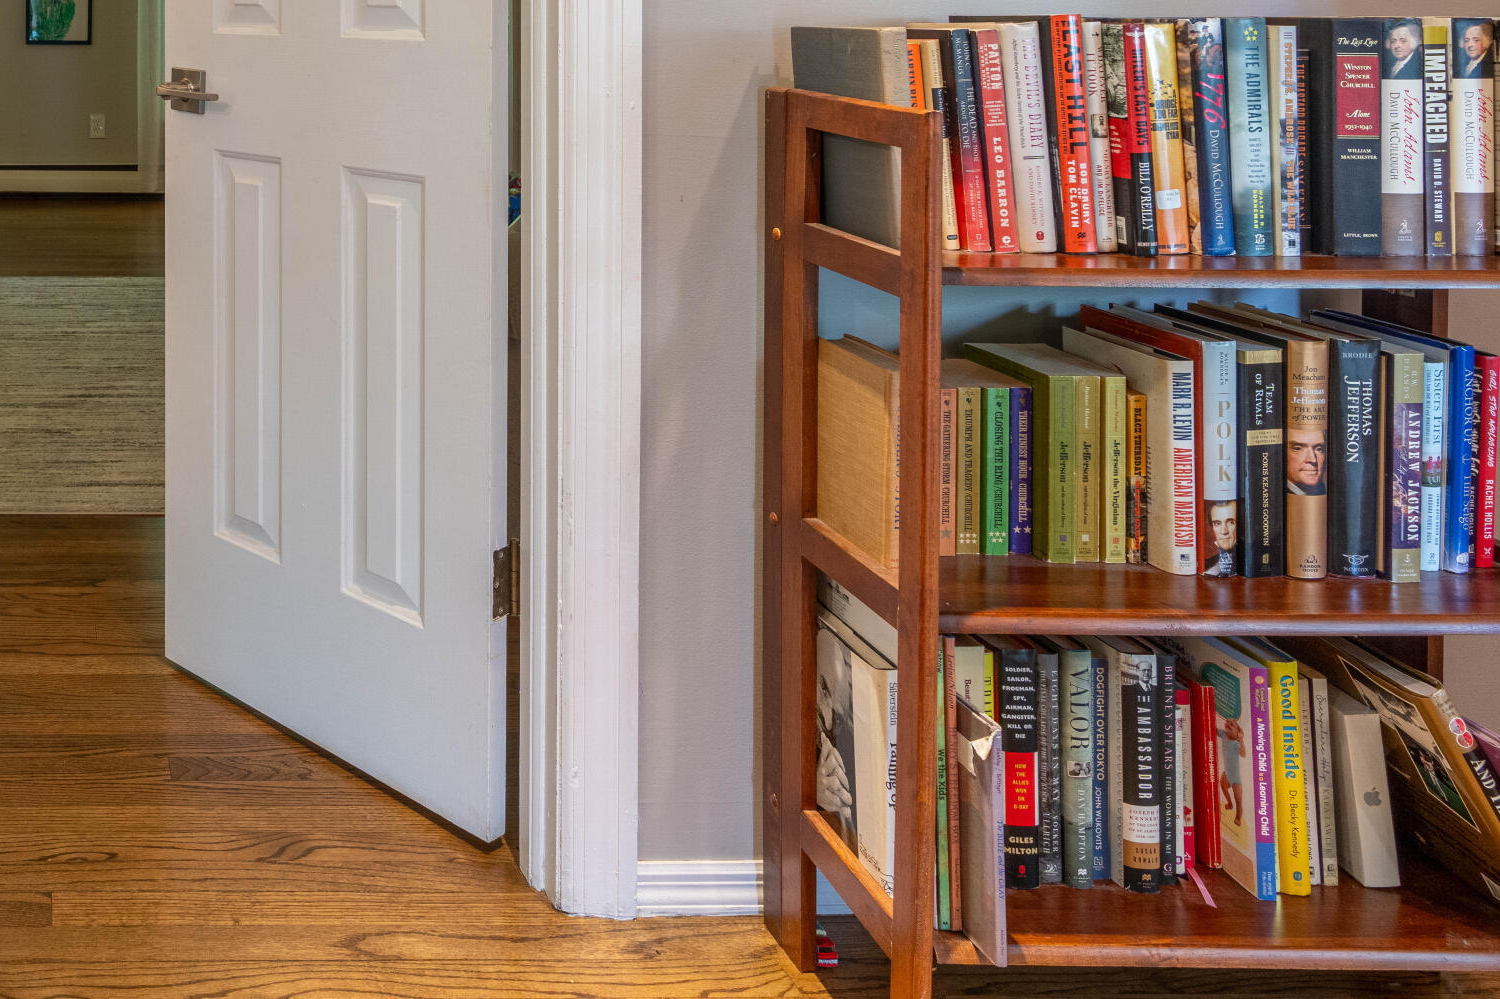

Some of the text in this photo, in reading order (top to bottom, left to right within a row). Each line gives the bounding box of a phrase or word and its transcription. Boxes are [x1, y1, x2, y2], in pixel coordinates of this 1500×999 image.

[988, 43, 1003, 90] PATTON
[1244, 45, 1260, 68] THE
[1337, 37, 1350, 46] The
[966, 86, 978, 128] THE DEAD
[1024, 65, 1045, 149] DEVIL'S DIARY
[1062, 29, 1087, 154] LAST HILL
[1087, 69, 1098, 97] TOOK
[1195, 72, 1226, 129] 1776
[1246, 72, 1263, 134] ADMIRALS
[1389, 92, 1401, 118] DAVID
[1424, 48, 1448, 145] IMPEACHED
[1464, 91, 1475, 118] DAVID
[961, 122, 971, 149] TO DIE
[1134, 94, 1149, 146] LAST DAYS
[1345, 109, 1371, 118] Alone
[992, 136, 1004, 163] LEO
[1209, 129, 1221, 160] DAVID
[1286, 159, 1295, 179] THE
[996, 169, 1010, 228] BARRON
[1067, 159, 1080, 228] TOM CLAVIN
[1079, 162, 1091, 225] BOB DRURY
[1138, 161, 1154, 232] BILL O'REILLY
[1433, 158, 1443, 223] DAVID STEWART
[1293, 386, 1325, 395] Thomas
[1304, 365, 1318, 373] Jon
[1433, 369, 1443, 412] Sisters
[1171, 372, 1193, 441] MARK LEVIN
[1255, 373, 1264, 426] OF RIVALS
[1265, 383, 1275, 414] TEAM
[1343, 375, 1361, 463] JEFFERSON
[1362, 378, 1373, 437] THOMAS
[1463, 368, 1474, 446] ANCHOR UP
[964, 408, 973, 459] TRIUMPH AND
[994, 411, 1004, 486] CLOSING THE RING
[1018, 433, 1028, 479] FINEST HOUR
[1112, 439, 1121, 477] Jefferson
[1134, 407, 1142, 476] BLACK THURSDAY
[941, 409, 951, 525] THE GATHERING CHURCHILL
[1059, 441, 1069, 483] Jefferson
[1082, 441, 1092, 483] Jefferson
[1173, 447, 1193, 498] AMERICAN
[1407, 410, 1421, 541] ANDREW JACKSON
[1463, 475, 1472, 497] Tim
[1112, 490, 1120, 526] Virginian
[1173, 500, 1194, 548] MARXISM
[1262, 509, 1270, 547] GOODWIN
[1483, 479, 1494, 540] RACHEL HOLLIS
[1004, 666, 1033, 674] SOLDIER,
[1164, 665, 1173, 719] BRITNEY
[889, 682, 897, 726] Silverstein
[1004, 704, 1034, 712] AIRMAN,
[1069, 666, 1090, 751] VALOR
[1096, 667, 1106, 781] DOGFIGHT OVER TOKYO
[1279, 675, 1300, 780] Good Inside
[1051, 717, 1060, 802] DAYS MAY
[1137, 707, 1153, 799] AMBASSADOR
[1164, 724, 1173, 771] SPEARS
[938, 749, 947, 801] We the Kids
[1256, 722, 1270, 837] Moving Child Learning Child
[1470, 759, 1497, 790] AND
[1008, 836, 1034, 844] GILES
[1077, 789, 1087, 861] DAN HAMPTON
[1094, 787, 1103, 850] JOHN WUKOVITS
[1165, 831, 1172, 840] IN
[1288, 790, 1301, 859] Dr. Becky Kennedy
[1003, 846, 1038, 855] MILTON
